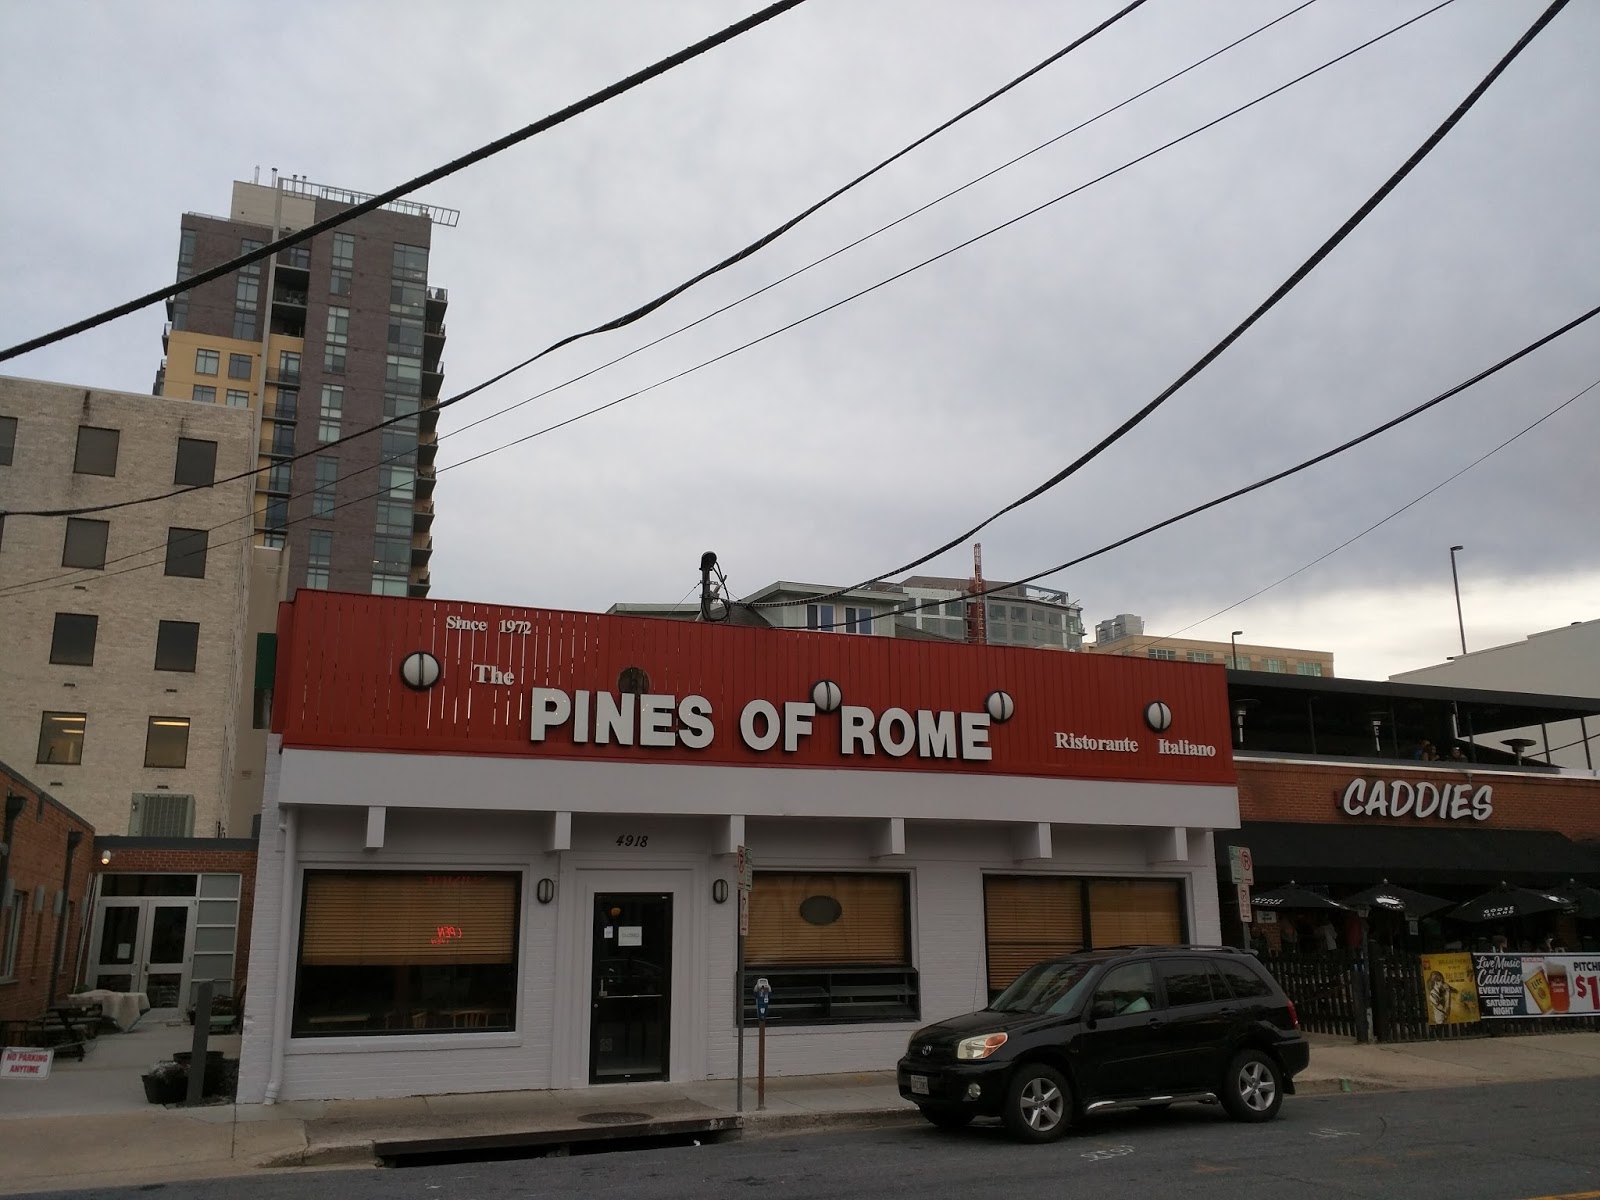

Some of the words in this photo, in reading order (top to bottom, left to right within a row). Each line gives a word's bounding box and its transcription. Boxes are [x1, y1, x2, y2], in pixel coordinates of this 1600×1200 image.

[446, 616, 487, 631] Since
[500, 620, 531, 635] 1972
[474, 664, 514, 685] The
[530, 687, 715, 748] PINES
[740, 699, 816, 752] OF
[841, 705, 992, 760] ROME
[1054, 732, 1139, 752] Ristorante
[1158, 739, 1216, 757] Italiano
[1343, 778, 1493, 821] CADDIES
[616, 834, 649, 848] 4918
[1483, 910, 1514, 918] ISLAND
[1484, 906, 1515, 914] GOOSE
[1476, 955, 1495, 969] Live
[1494, 955, 1521, 969] Music
[1477, 969, 1521, 986] Caddies
[1478, 986, 1499, 994] EVERY
[1501, 986, 1523, 994] FRIDAY
[1486, 999, 1519, 1007] SATURDAY
[1492, 1007, 1515, 1015] NIGHT
[7, 1053, 17, 1061] NO
[18, 1054, 48, 1062] PARKING
[9, 1065, 40, 1073] ANYTIME
